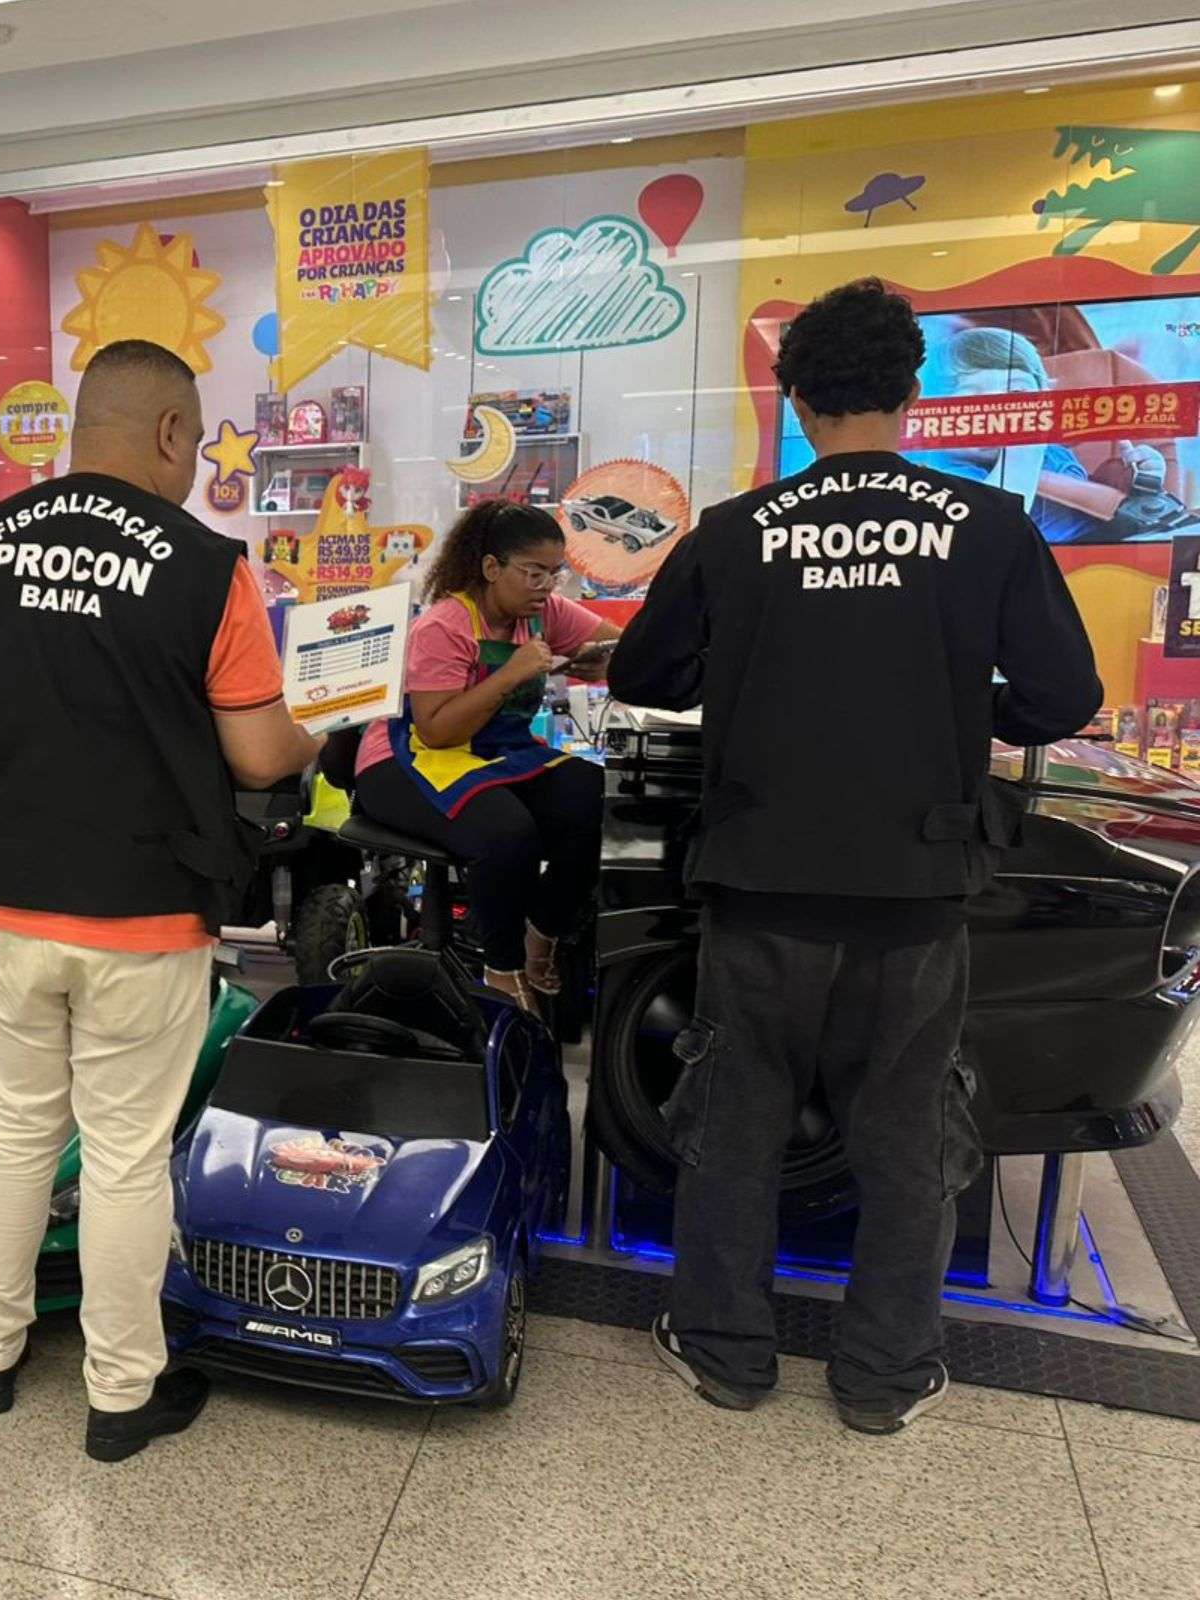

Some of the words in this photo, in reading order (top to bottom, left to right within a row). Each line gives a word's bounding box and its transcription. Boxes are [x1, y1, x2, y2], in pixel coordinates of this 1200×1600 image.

[299, 208, 316, 227] O
[319, 204, 358, 226] DIA
[362, 198, 406, 221] DAS
[299, 219, 406, 247] CRIANÇAS
[297, 239, 406, 267] APROVADO
[296, 264, 326, 282] POR
[329, 258, 405, 279] CRIANÇAS
[6, 401, 58, 415] compre
[906, 406, 948, 417] OFERTAS
[1003, 400, 1055, 412] CRIANÇAS
[1061, 394, 1091, 411] ATÉ
[905, 410, 1055, 438] PRESENTES
[1142, 413, 1177, 424] CADA
[752, 472, 971, 527] FISCALIZAÇÃO
[761, 519, 955, 563] PROCON
[801, 562, 902, 589] BAHIA
[19, 583, 103, 618] BAHIA
[272, 1325, 333, 1346] AMG
